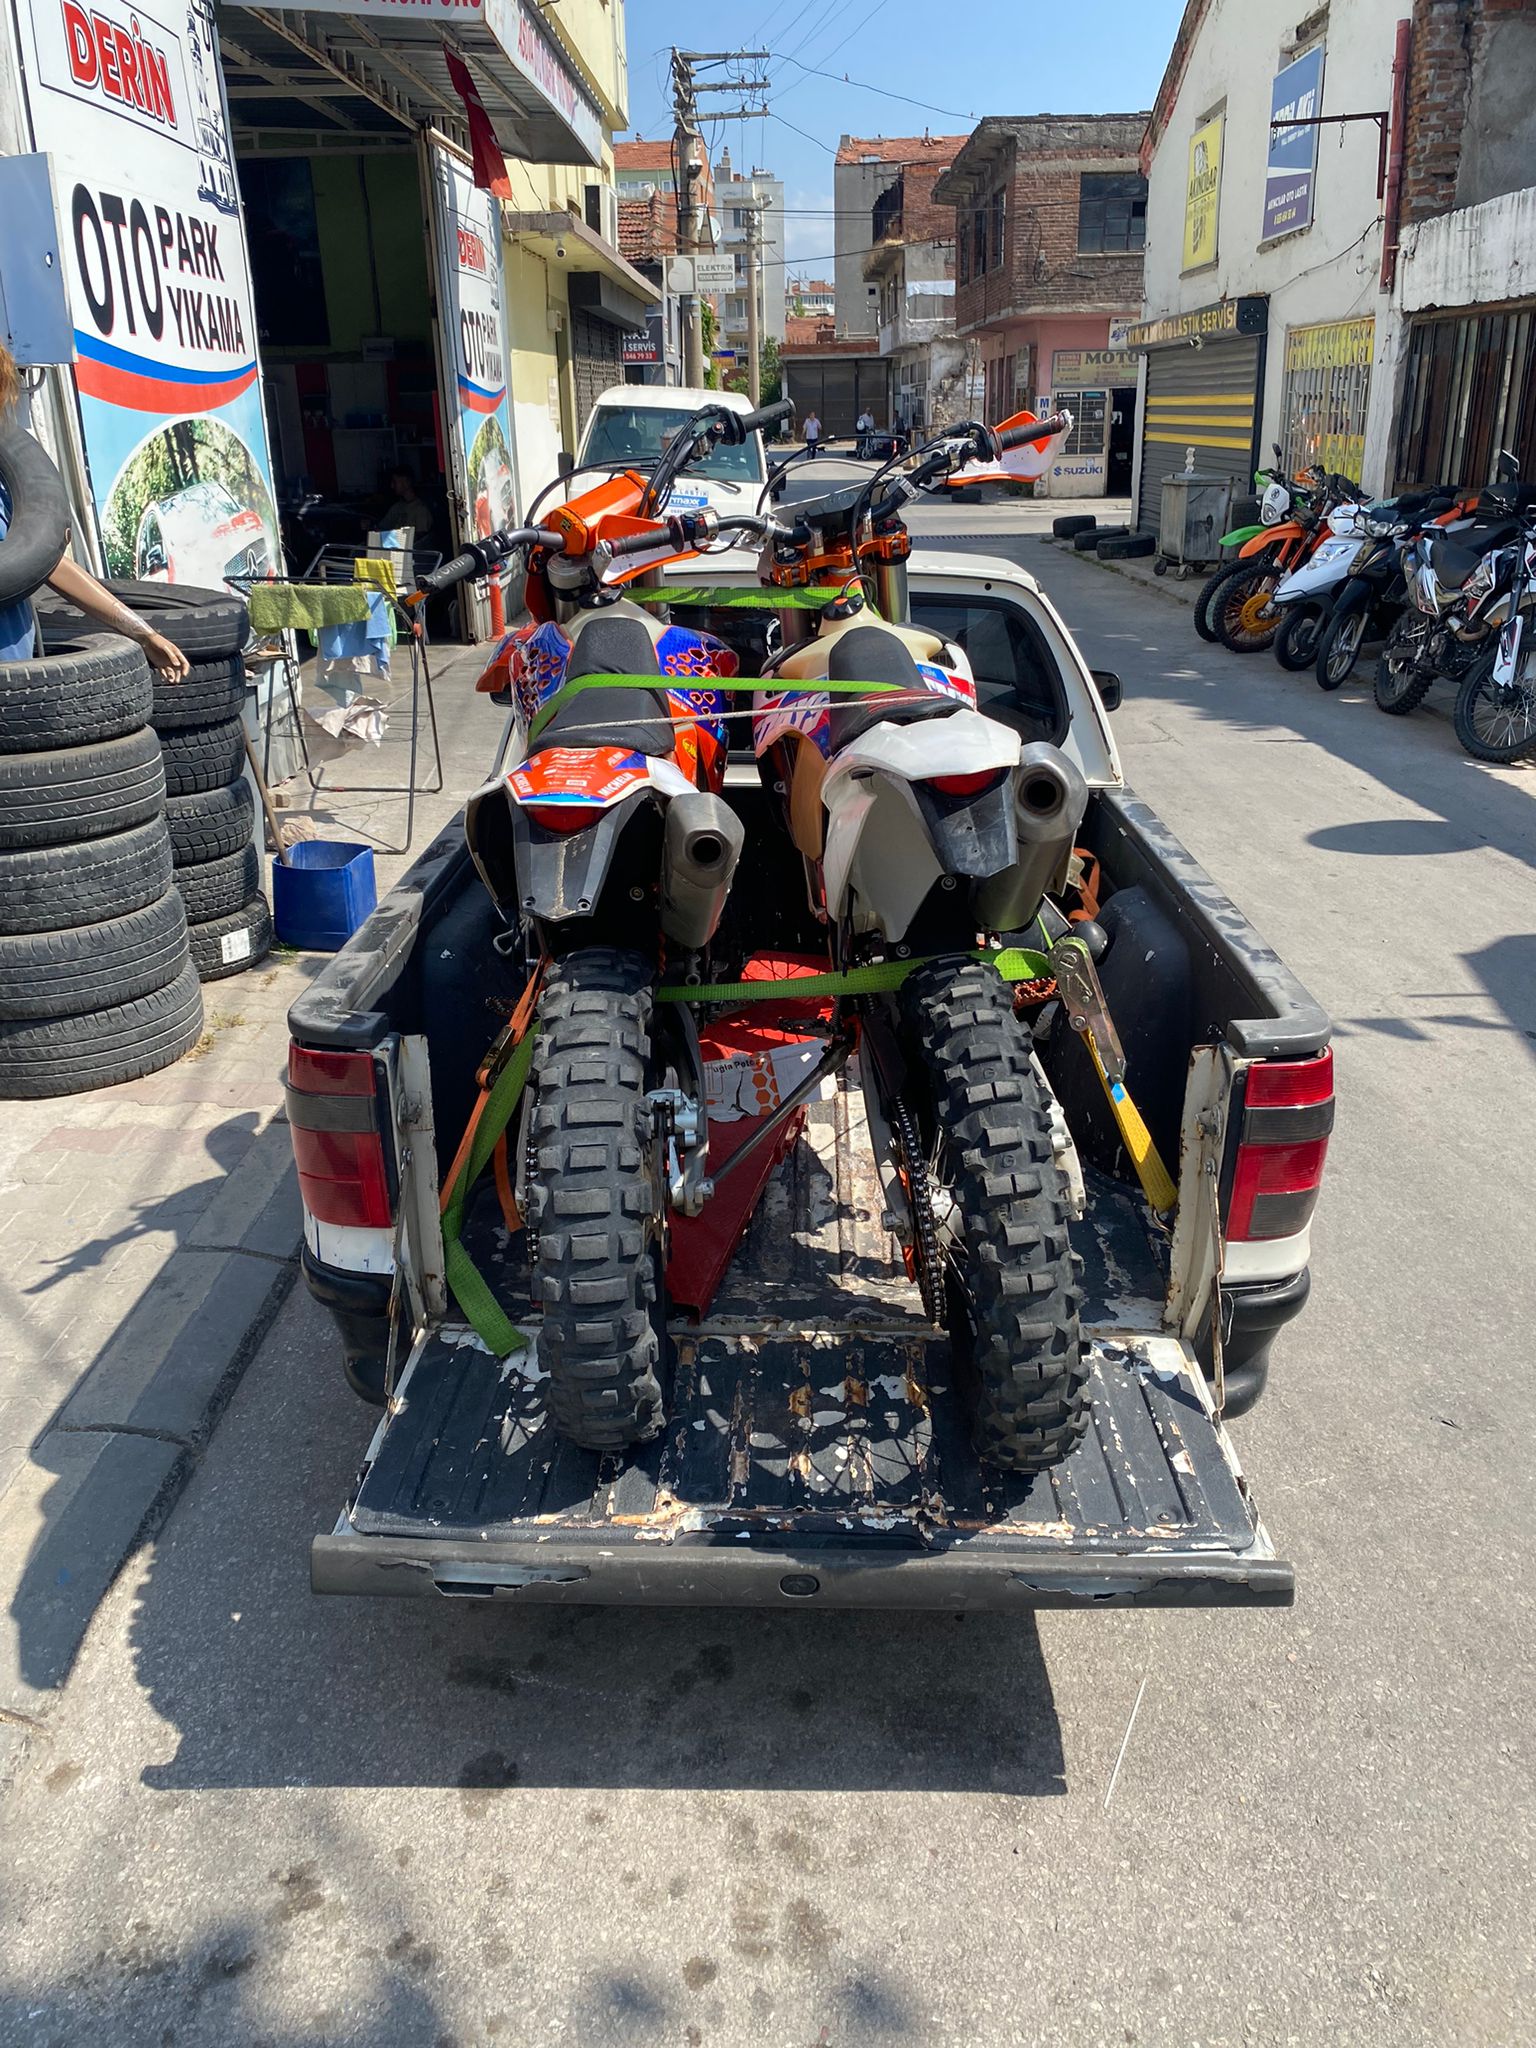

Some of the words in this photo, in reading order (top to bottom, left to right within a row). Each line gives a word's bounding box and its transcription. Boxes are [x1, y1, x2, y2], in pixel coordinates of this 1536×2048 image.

[60, 0, 178, 130] DERİN
[72, 183, 164, 342] OTO
[154, 204, 225, 282] PARK
[166, 285, 246, 355] YIKAMA
[1174, 312, 1200, 338] LASTİK
[460, 308, 485, 379] OTO
[628, 341, 656, 352] SERVİS
[1085, 352, 1139, 364] MOTO
[1064, 466, 1103, 475] SUZUKI
[597, 771, 636, 797] MICHELIN
